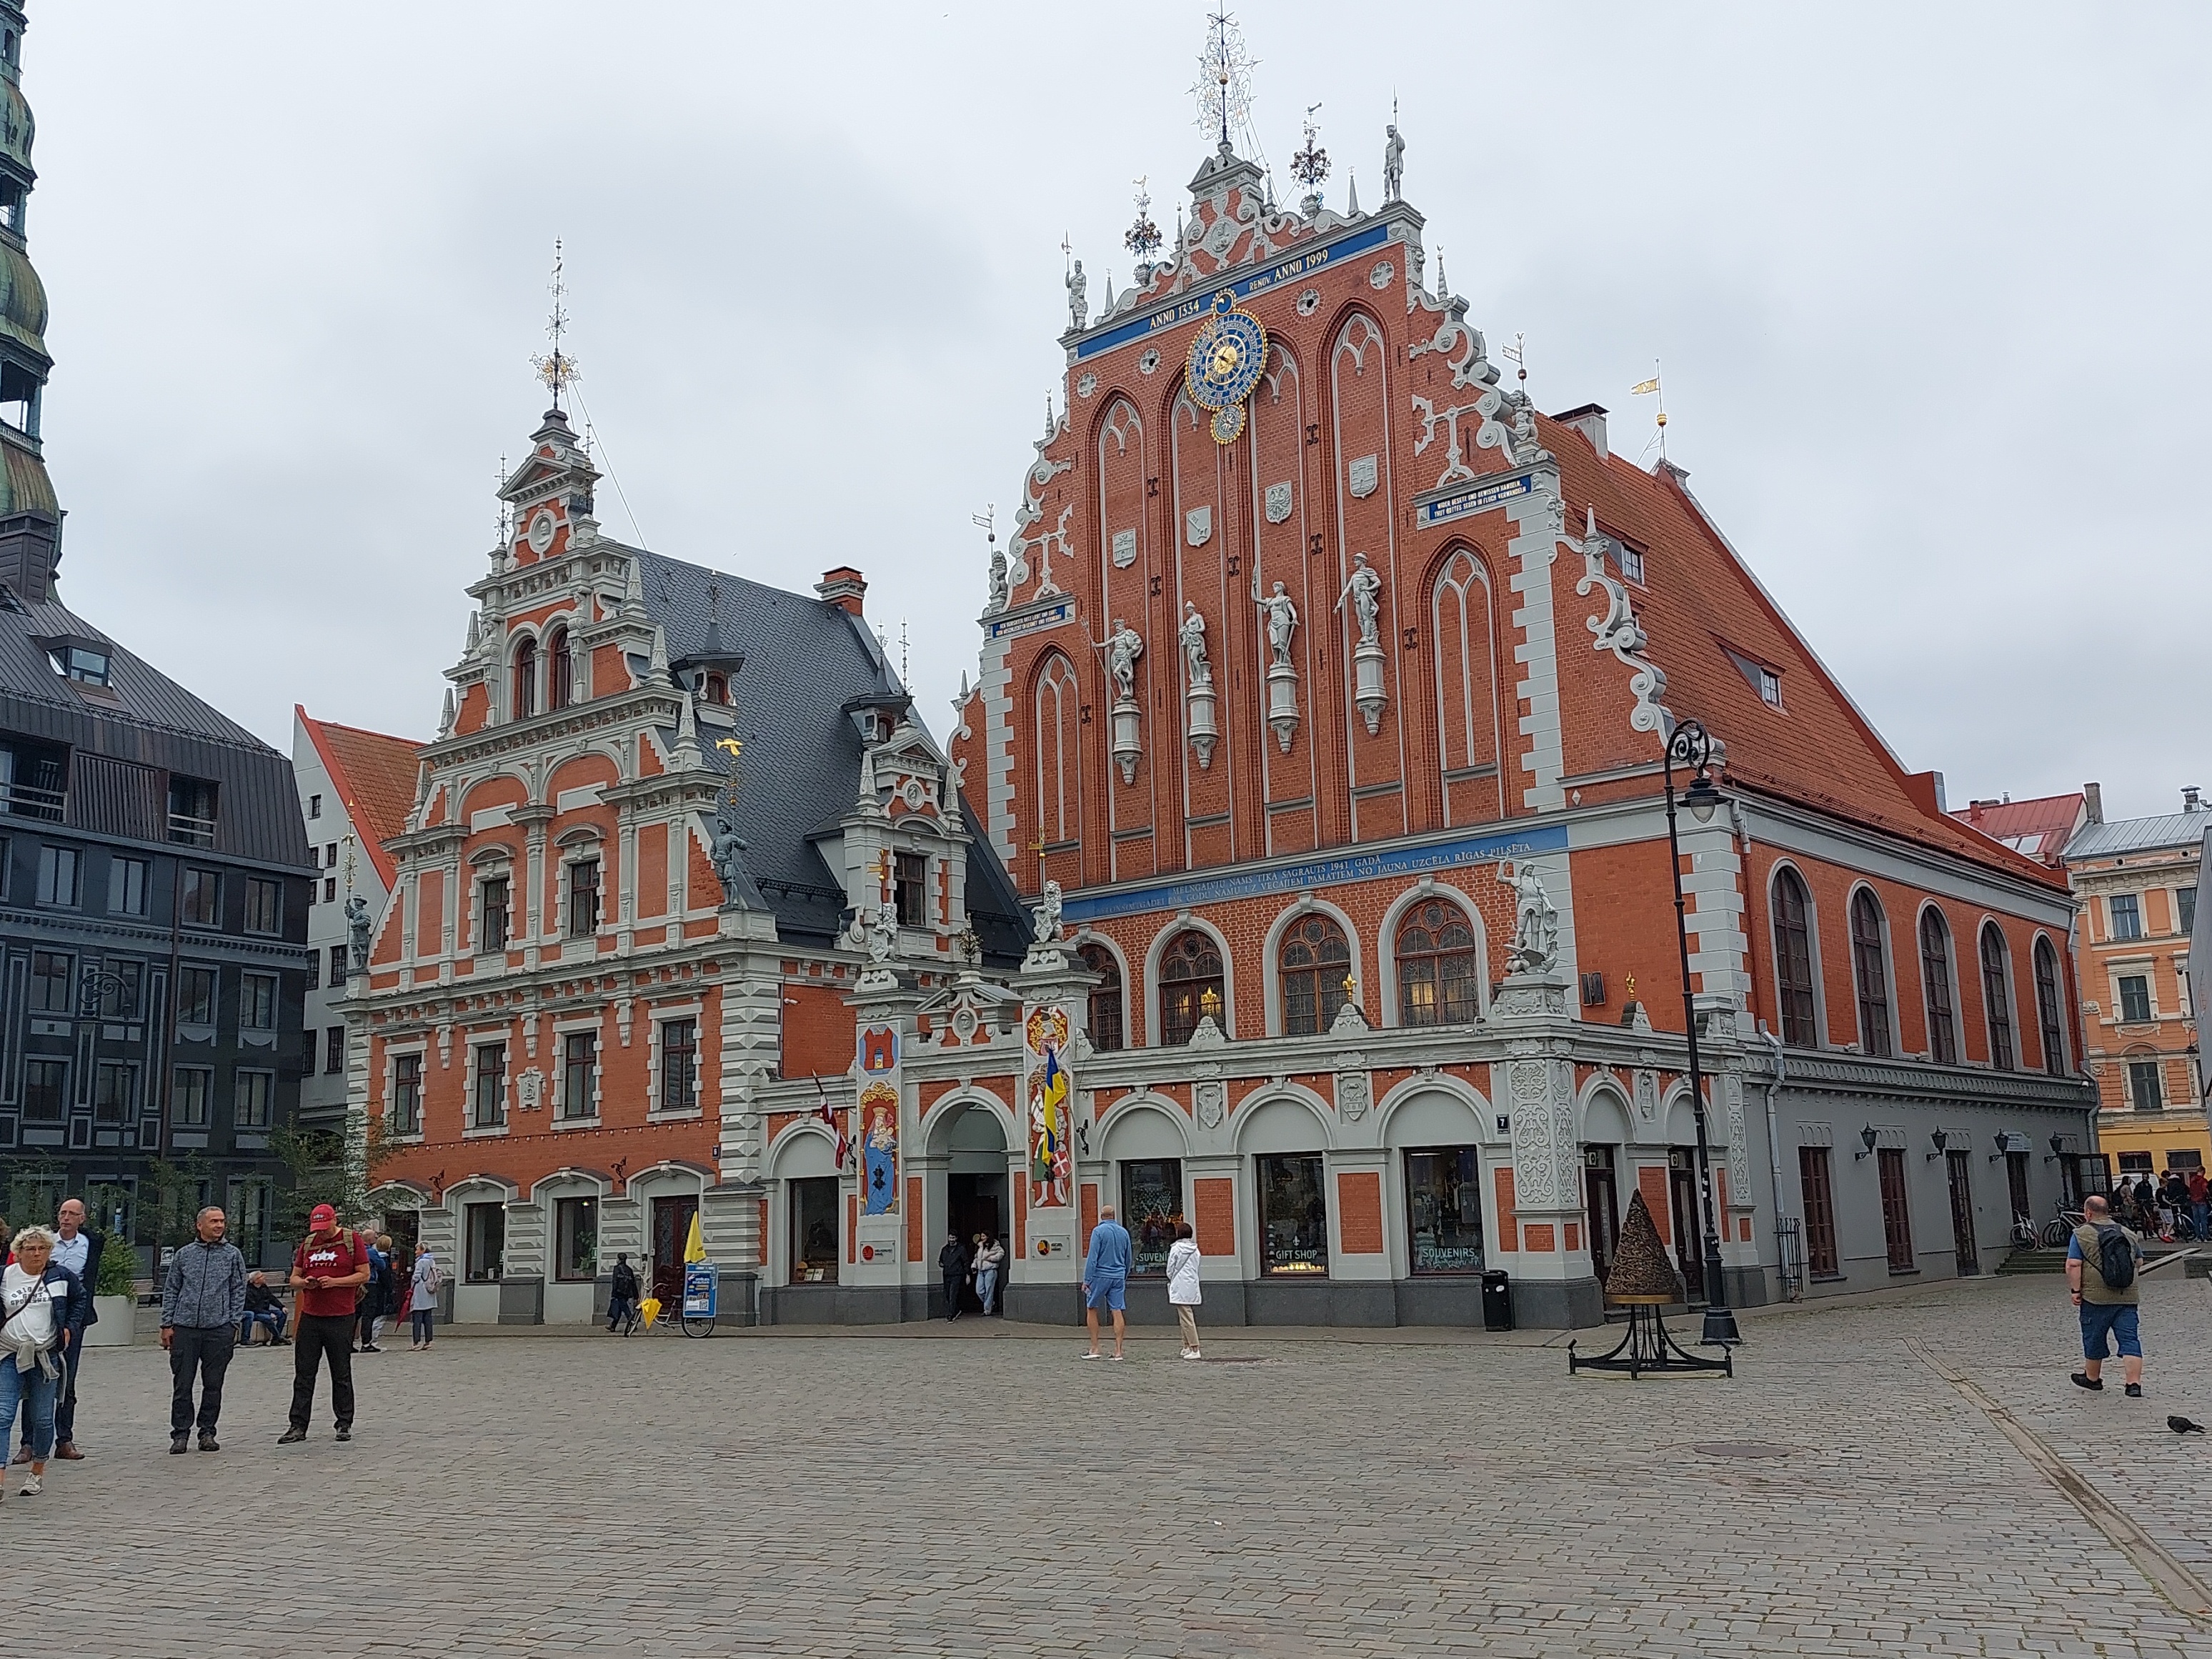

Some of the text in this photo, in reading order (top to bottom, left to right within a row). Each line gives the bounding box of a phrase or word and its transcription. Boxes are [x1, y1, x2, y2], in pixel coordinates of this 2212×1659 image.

[1149, 309, 1175, 329] ANNO
[1178, 299, 1200, 319] 1334
[1275, 261, 1302, 282] ANNO
[1306, 249, 1328, 269] 1999
[1173, 880, 1225, 895] MELNGALVJU
[1229, 876, 1252, 887] NAMS
[1257, 872, 1277, 882] TIKA
[1282, 865, 1326, 879] SAGRAUTS
[1330, 861, 1348, 871] 1941
[1186, 892, 1210, 901] GODU
[1215, 887, 1240, 897] NAMU
[1245, 885, 1257, 893] UZ
[1261, 878, 1303, 891] VECAJIEM
[1308, 870, 1354, 883] PAMATIEM
[1357, 867, 1372, 876] NO
[1377, 862, 1408, 875] JAUNA
[1499, 1118, 1505, 1127] 7
[1275, 1249, 1317, 1260] GIFT SHOP
[1423, 1247, 1475, 1257] SOUVENIRS
